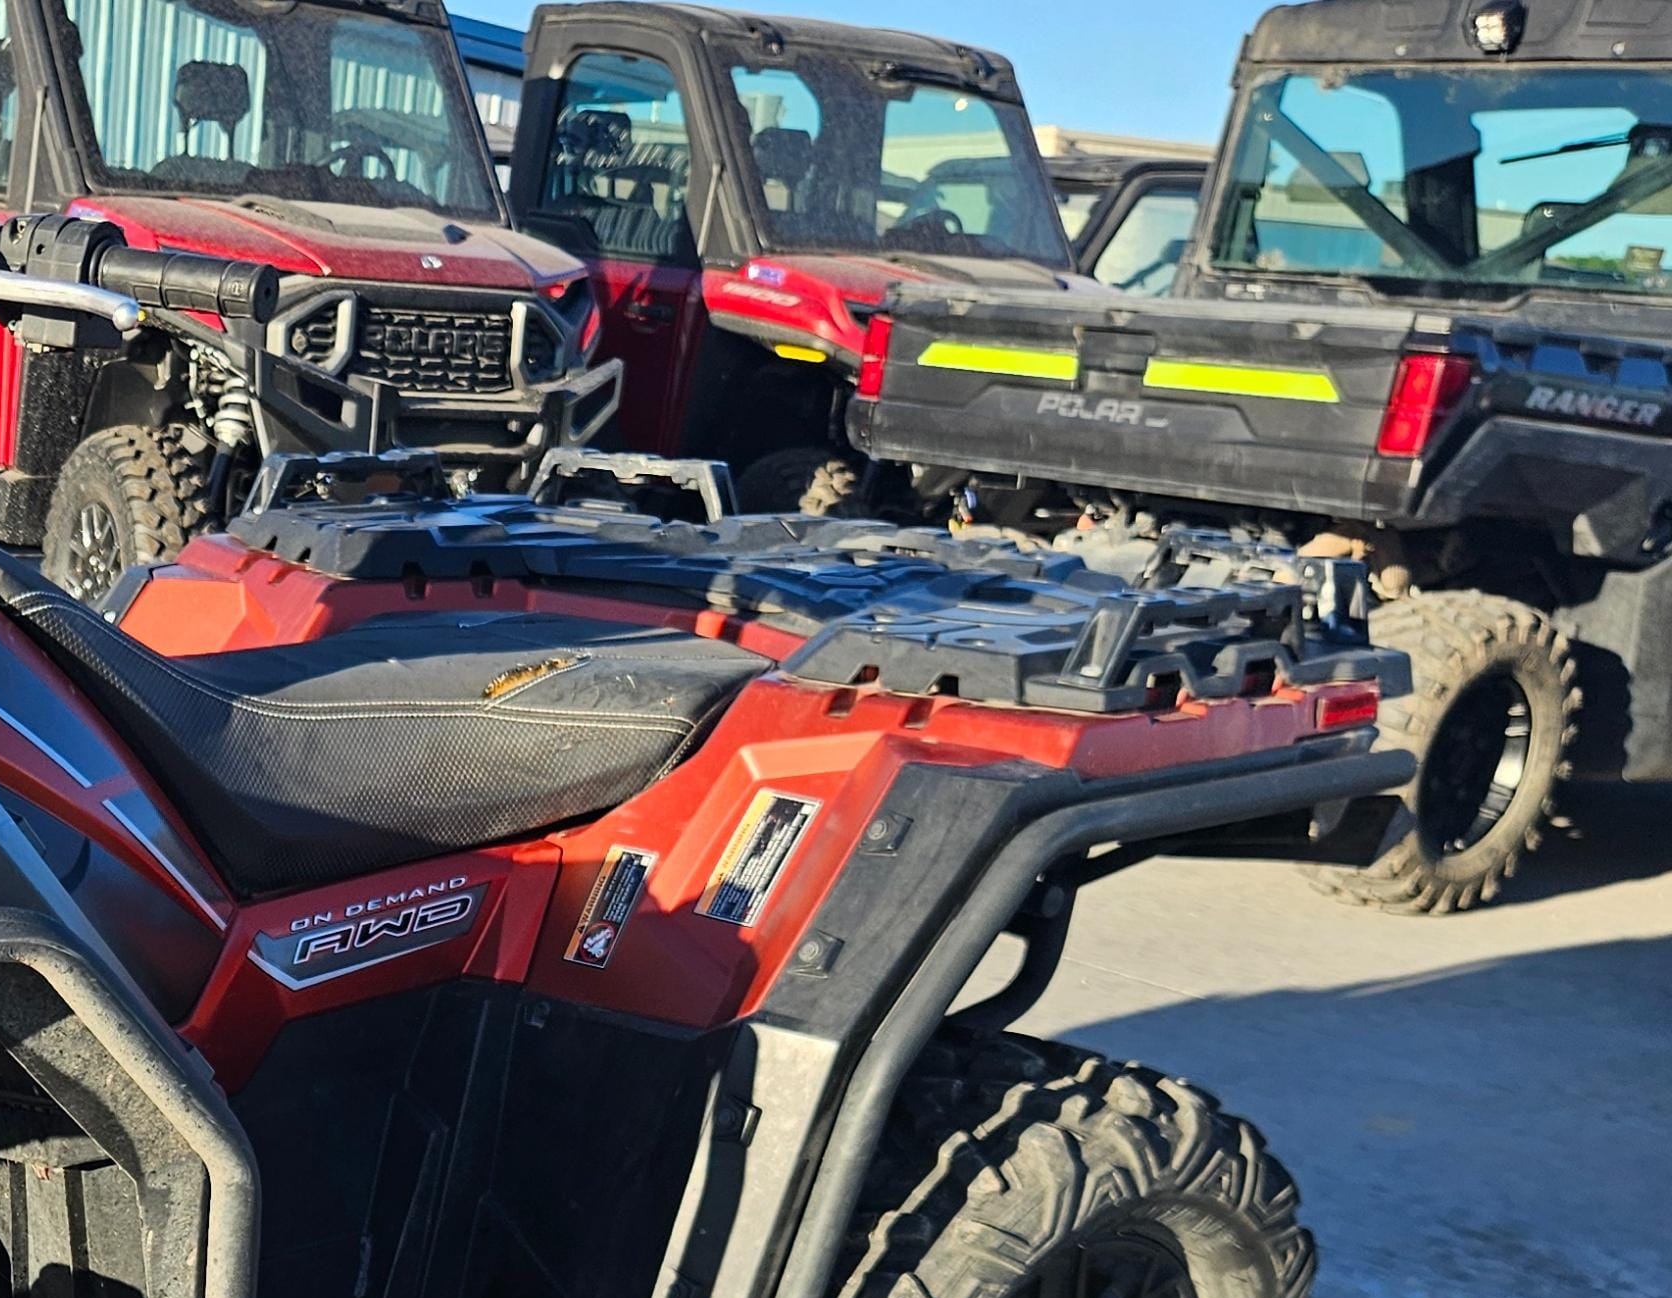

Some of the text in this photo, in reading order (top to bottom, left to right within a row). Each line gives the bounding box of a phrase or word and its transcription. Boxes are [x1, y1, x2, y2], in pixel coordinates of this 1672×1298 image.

[1525, 385, 1662, 426] RANGER
[290, 876, 467, 932] ON DEMAND
[582, 875, 607, 921] WARNING
[293, 894, 473, 965] AWD
